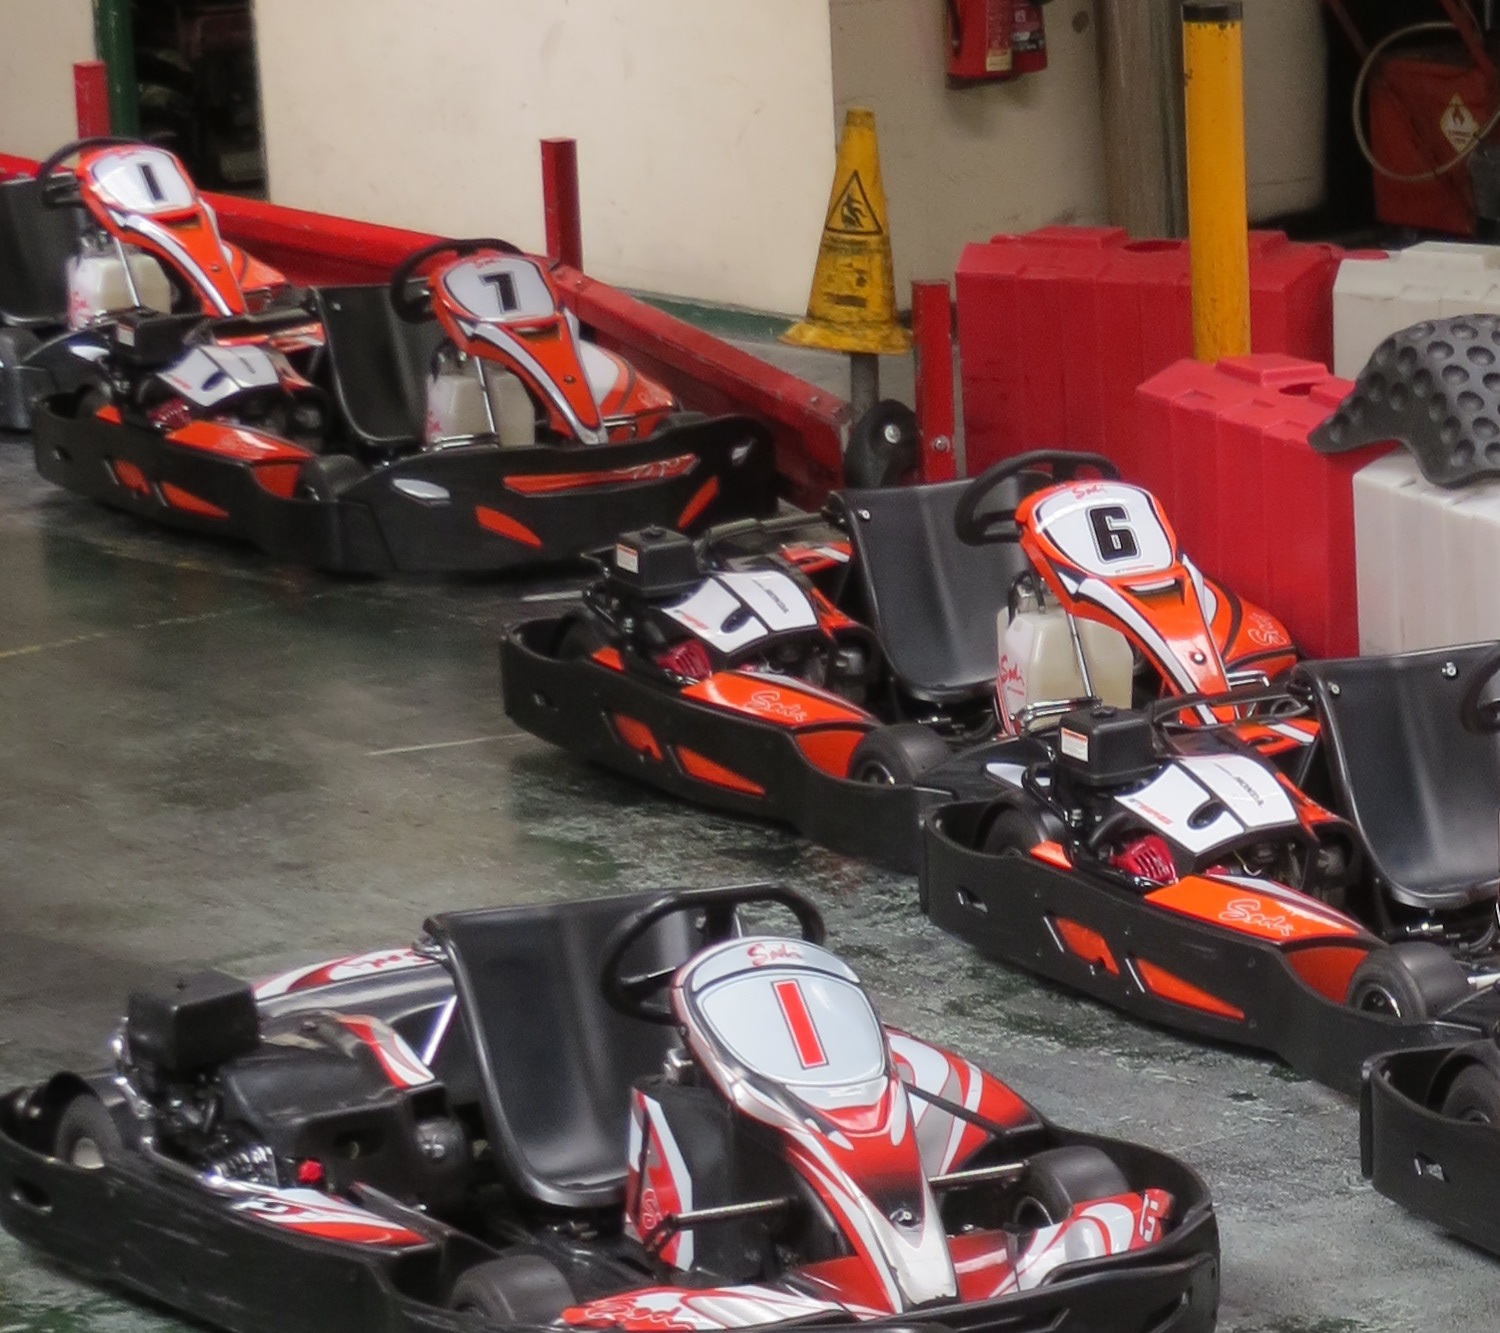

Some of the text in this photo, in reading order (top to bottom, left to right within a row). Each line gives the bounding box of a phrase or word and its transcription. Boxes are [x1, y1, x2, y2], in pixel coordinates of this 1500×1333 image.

[1085, 503, 1141, 564] 6
[1218, 897, 1295, 937] Sodi
[747, 943, 804, 967] Sodi
